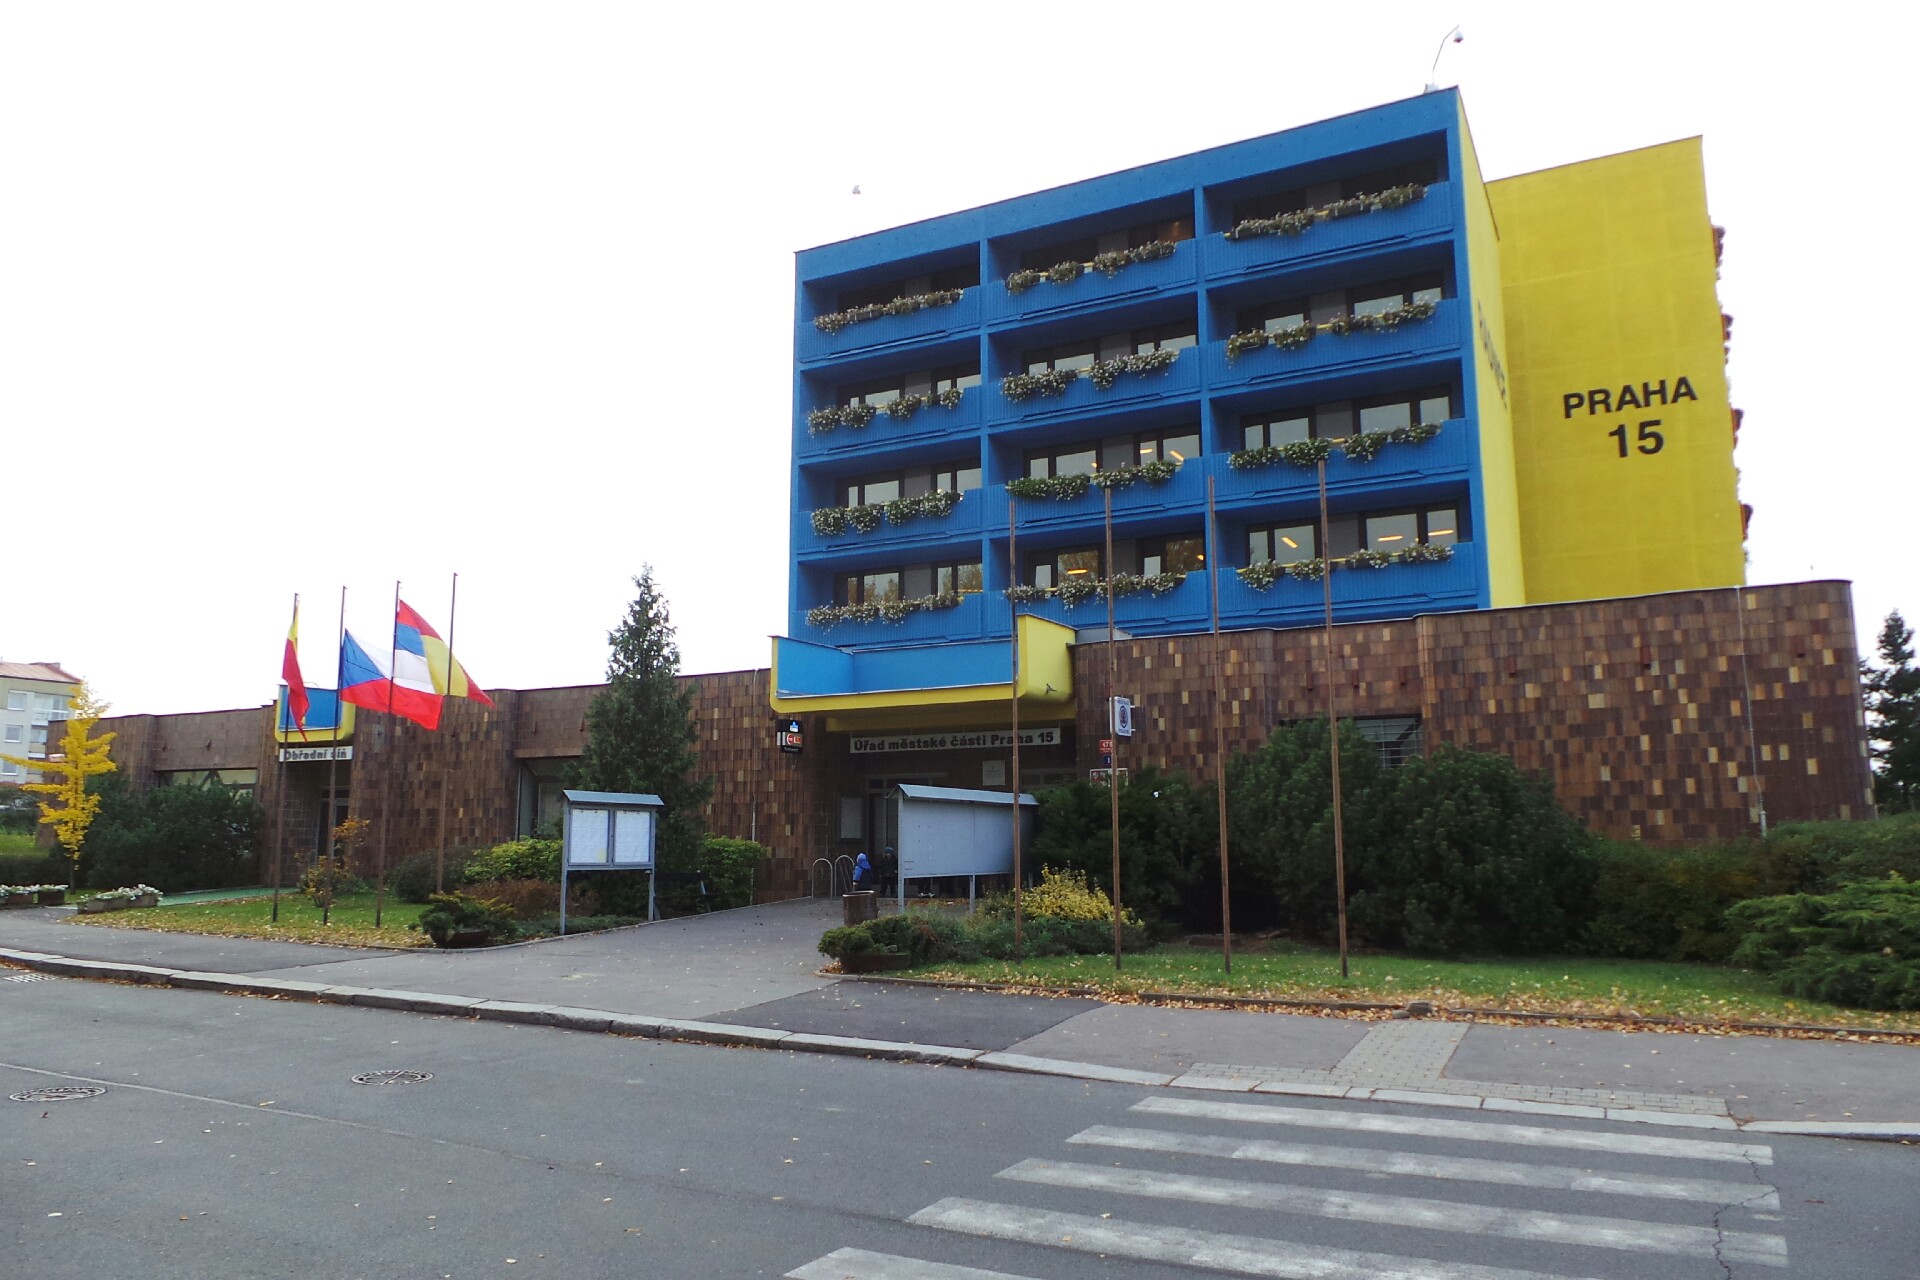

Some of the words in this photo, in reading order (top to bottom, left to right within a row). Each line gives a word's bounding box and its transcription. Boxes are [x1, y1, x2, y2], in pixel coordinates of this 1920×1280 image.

[1563, 376, 1698, 419] PRAHA
[1608, 419, 1664, 458] 15
[854, 739, 885, 751] Úřad
[888, 736, 946, 750] městské
[950, 735, 986, 747] části
[1038, 731, 1054, 743] 15
